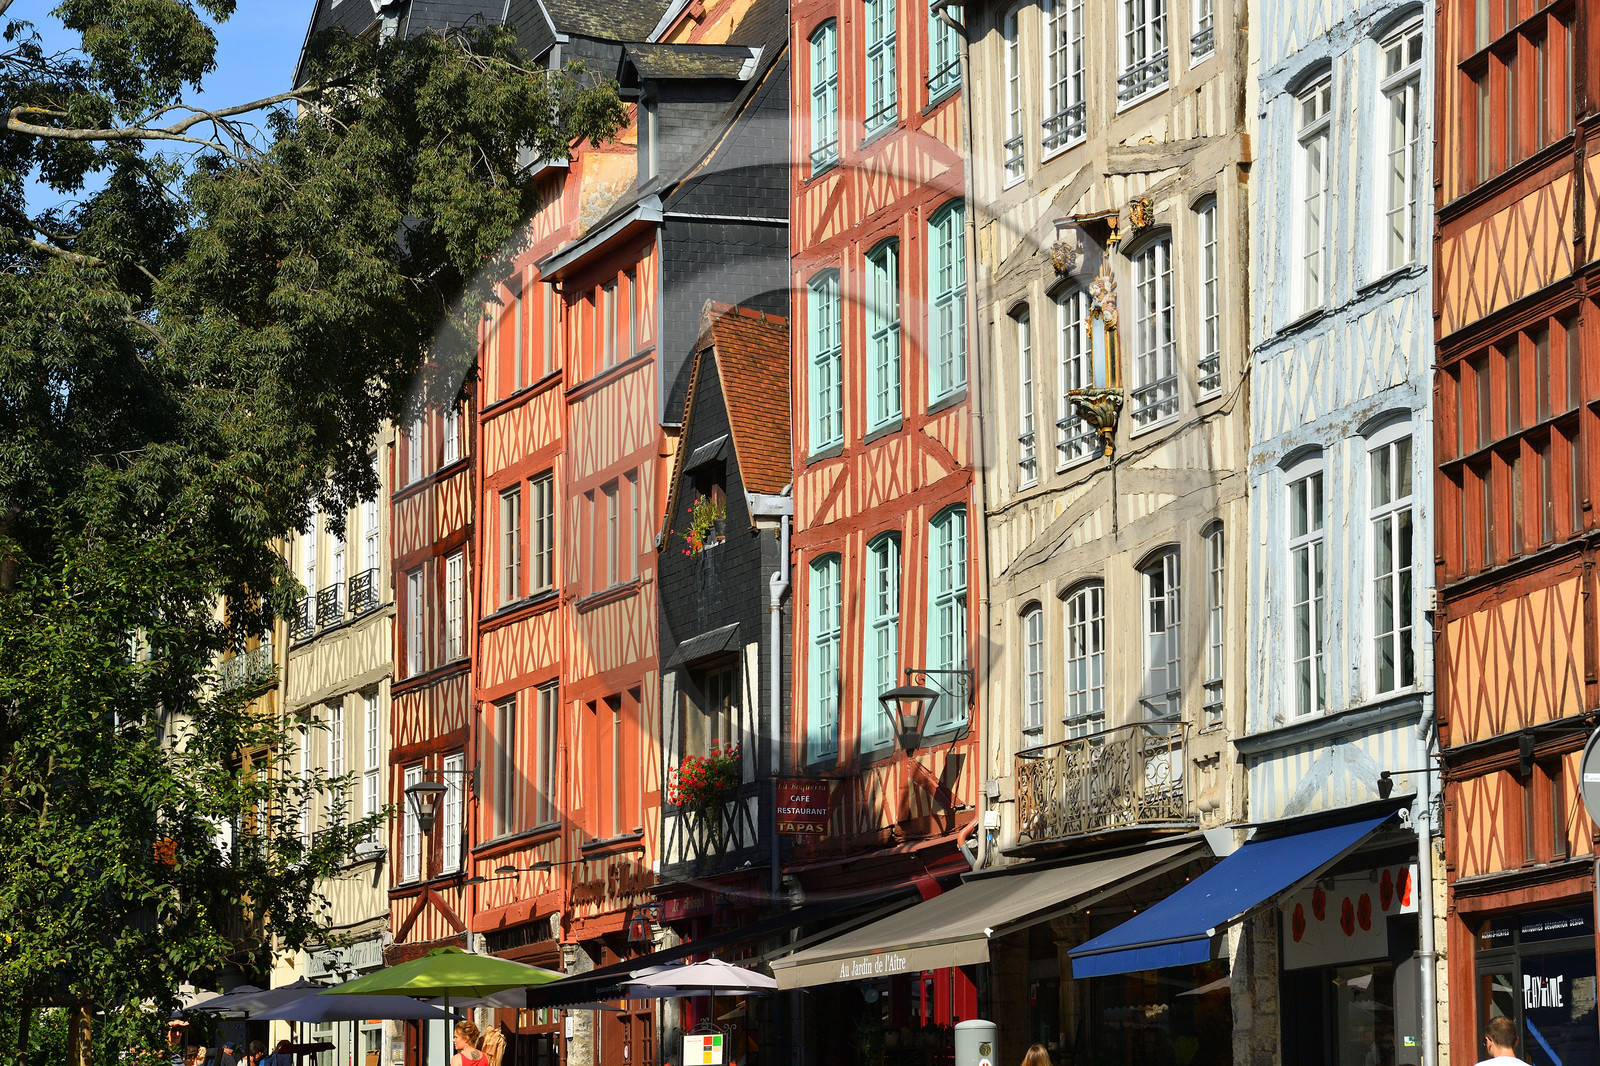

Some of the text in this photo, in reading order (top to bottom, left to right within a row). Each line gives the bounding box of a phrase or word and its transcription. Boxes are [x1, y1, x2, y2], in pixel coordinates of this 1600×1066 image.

[790, 795, 810, 803] CAFÉ
[777, 807, 827, 816] RESTAURANT
[777, 823, 824, 832] TAPAS
[840, 953, 906, 978] Au Jardin de l'Aître
